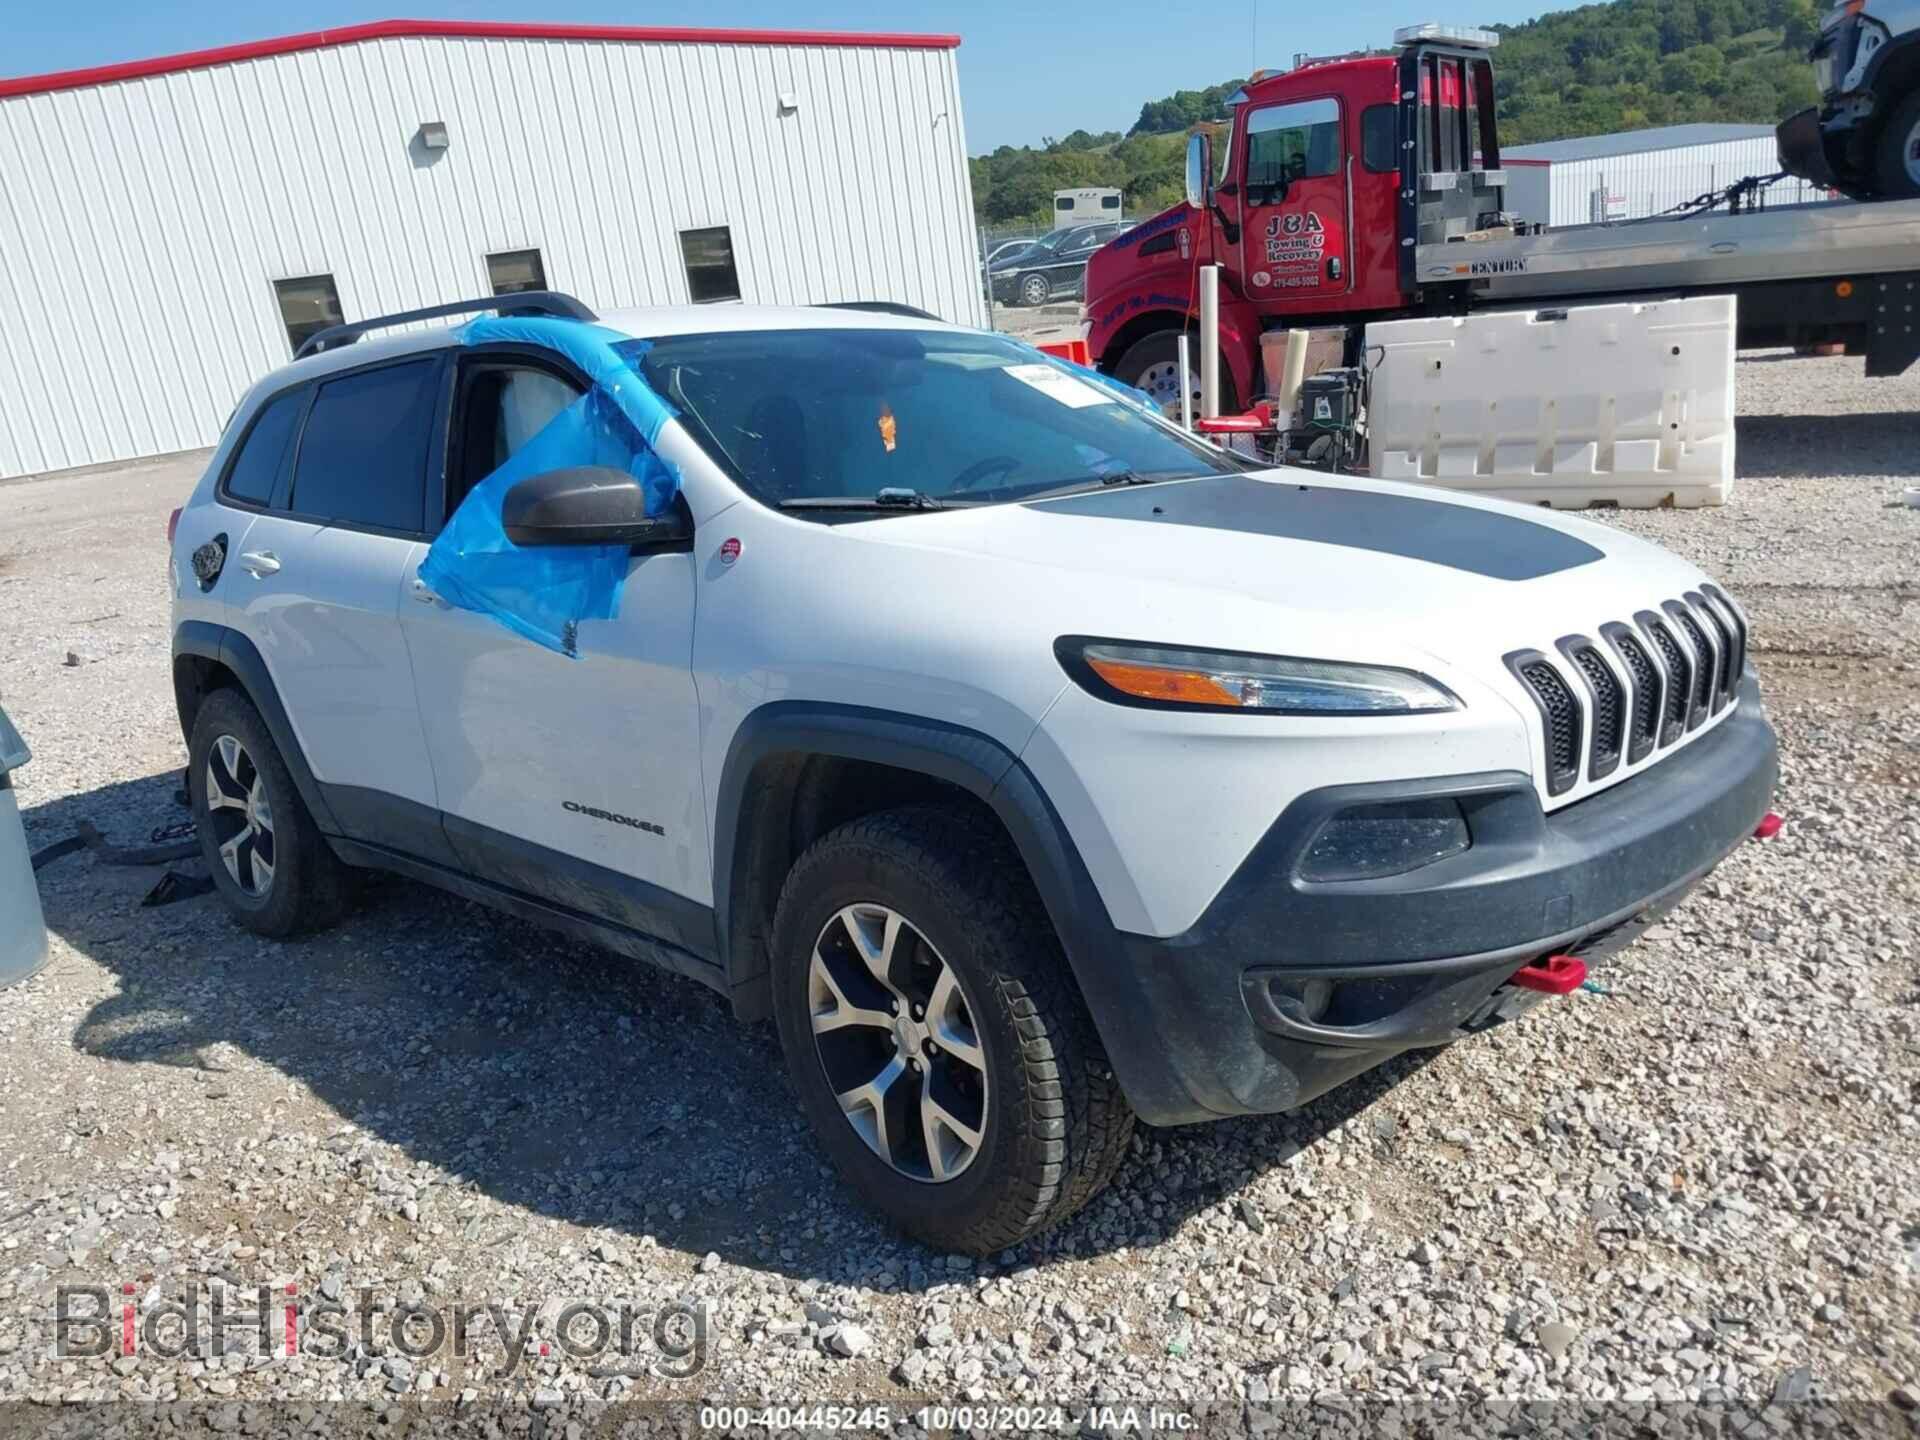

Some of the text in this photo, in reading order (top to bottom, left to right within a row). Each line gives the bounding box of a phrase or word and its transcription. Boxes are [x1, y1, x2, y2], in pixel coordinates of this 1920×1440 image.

[1266, 212, 1323, 236] J&A
[1266, 235, 1324, 251] Towing &
[1267, 249, 1323, 262] Recovery
[1472, 256, 1528, 273] CENTURY
[562, 801, 666, 836] CHEROKEE
